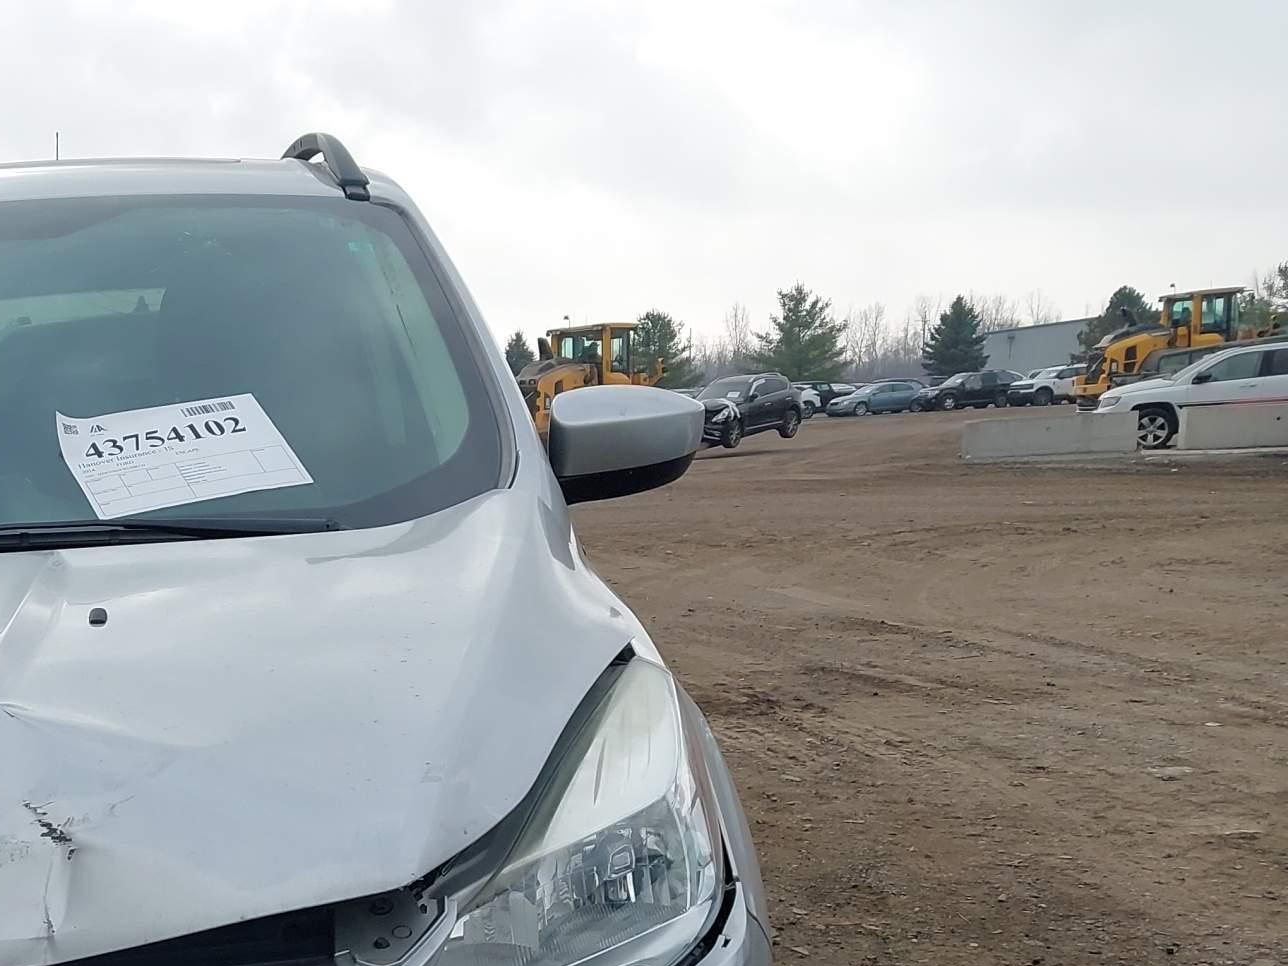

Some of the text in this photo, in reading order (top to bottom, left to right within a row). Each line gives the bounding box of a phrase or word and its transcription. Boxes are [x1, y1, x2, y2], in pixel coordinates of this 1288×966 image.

[85, 416, 247, 460] 43754102
[78, 457, 114, 470] Hanover
[115, 449, 157, 462] Insurance
